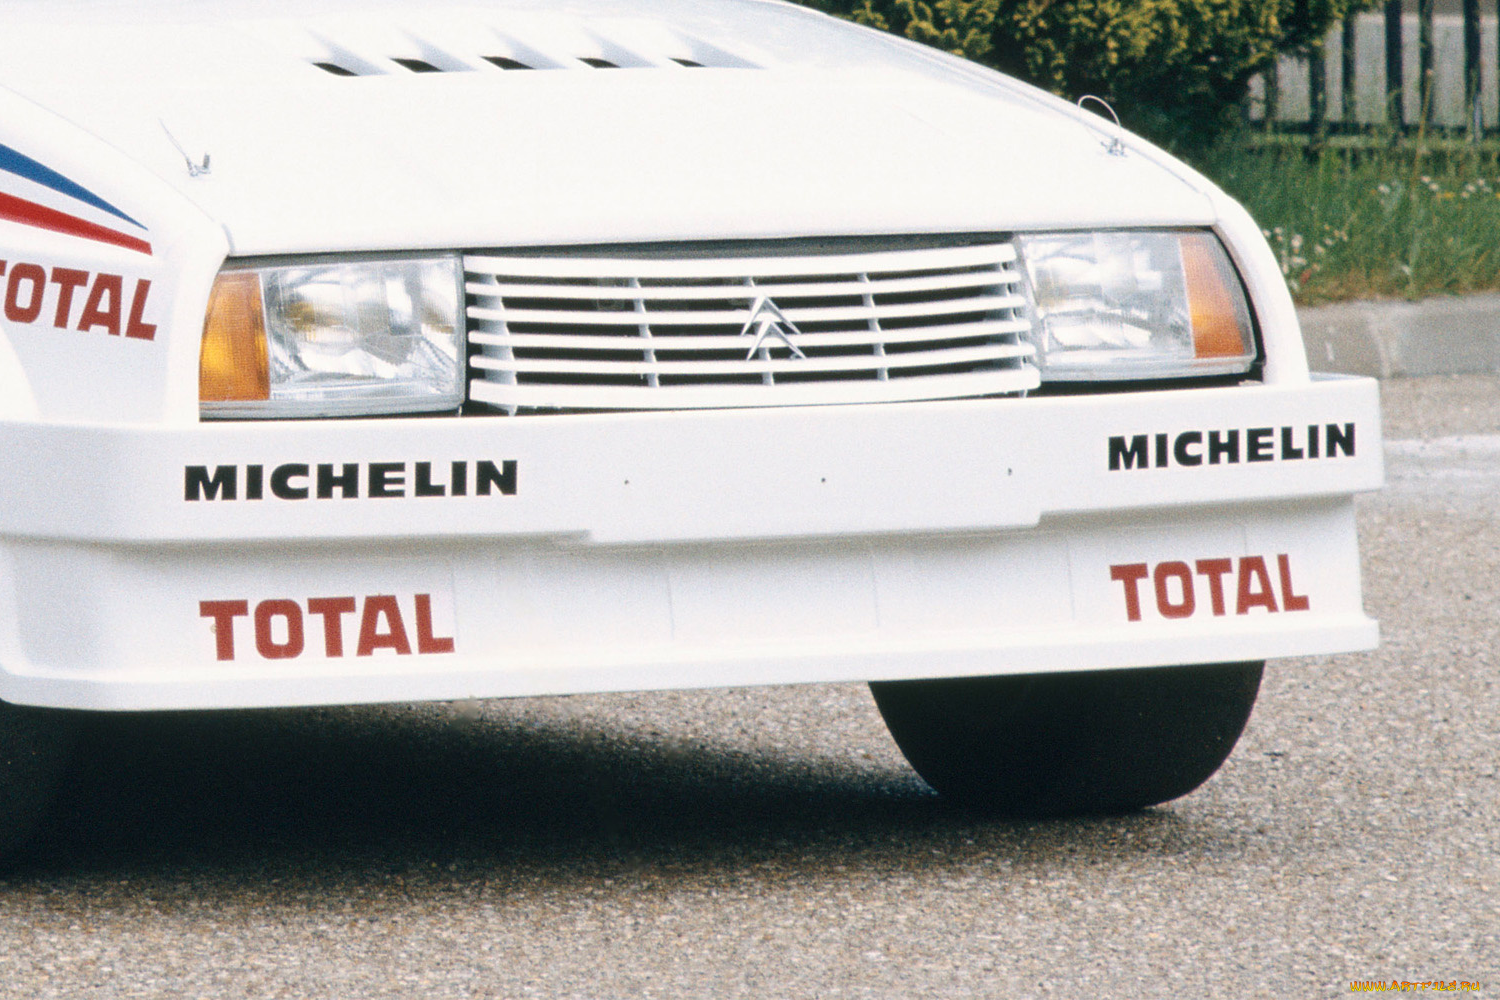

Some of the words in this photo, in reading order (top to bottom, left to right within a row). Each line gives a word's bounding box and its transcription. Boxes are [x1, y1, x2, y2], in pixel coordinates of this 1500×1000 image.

[1108, 422, 1355, 471] MICHELIN
[184, 460, 518, 501] MICHELIN
[1109, 553, 1310, 622] TOTAL
[200, 594, 455, 661] TOTAL
